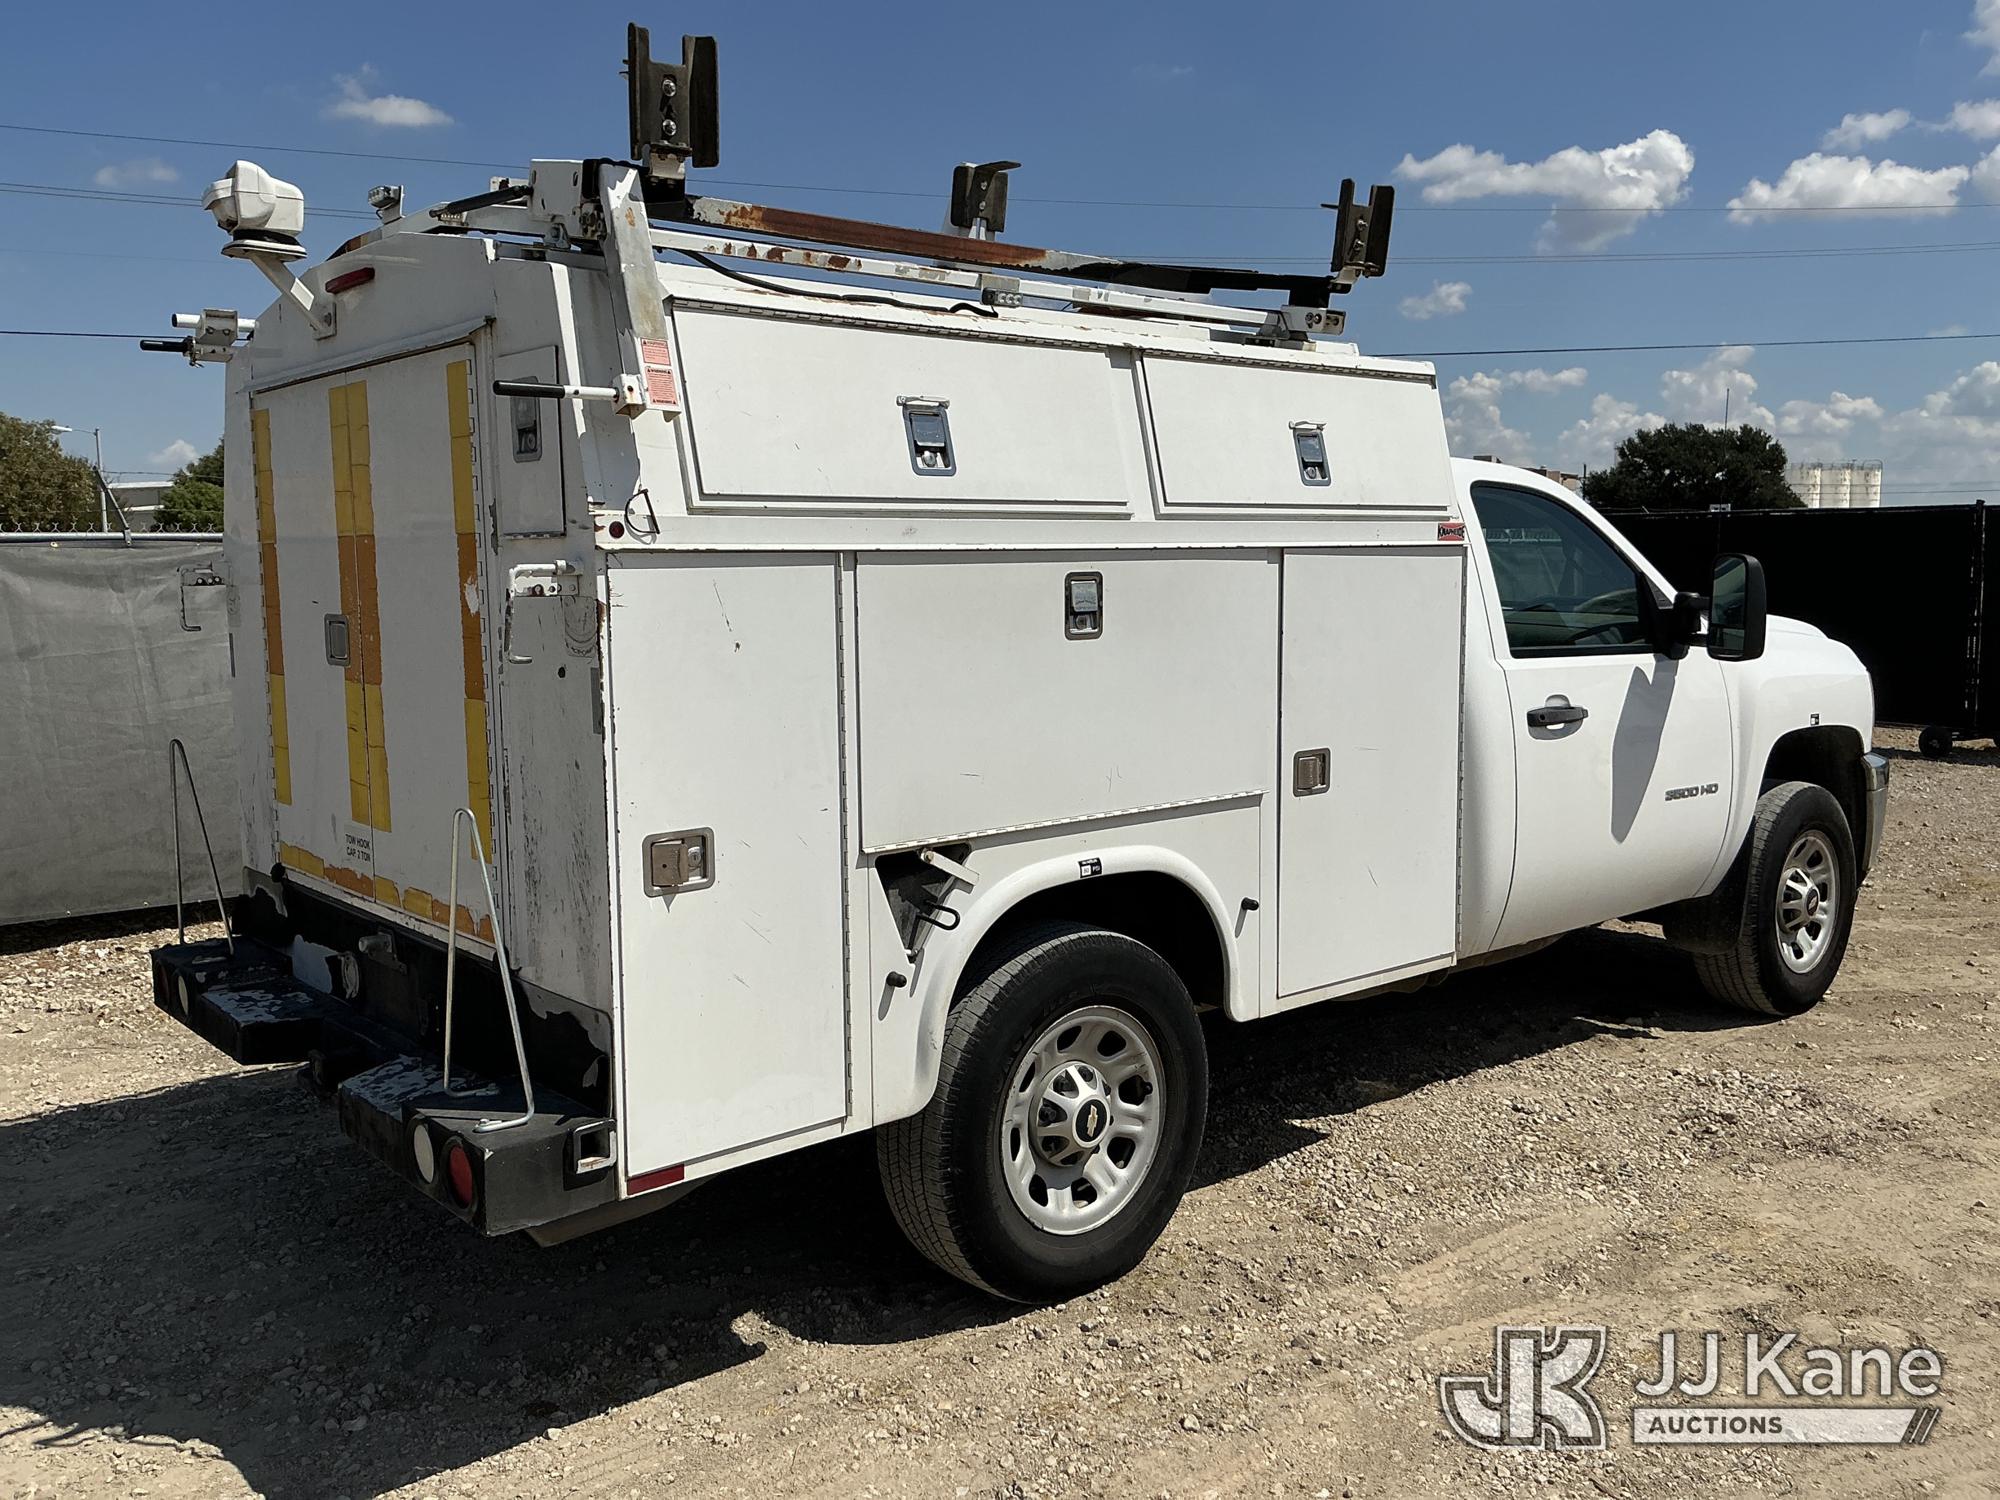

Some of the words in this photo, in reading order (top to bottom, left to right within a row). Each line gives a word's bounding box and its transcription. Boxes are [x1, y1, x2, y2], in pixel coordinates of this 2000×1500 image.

[1700, 782, 1719, 797] HD
[345, 833, 357, 846] TOW
[356, 837, 371, 850] HOOK
[360, 850, 371, 863] TON
